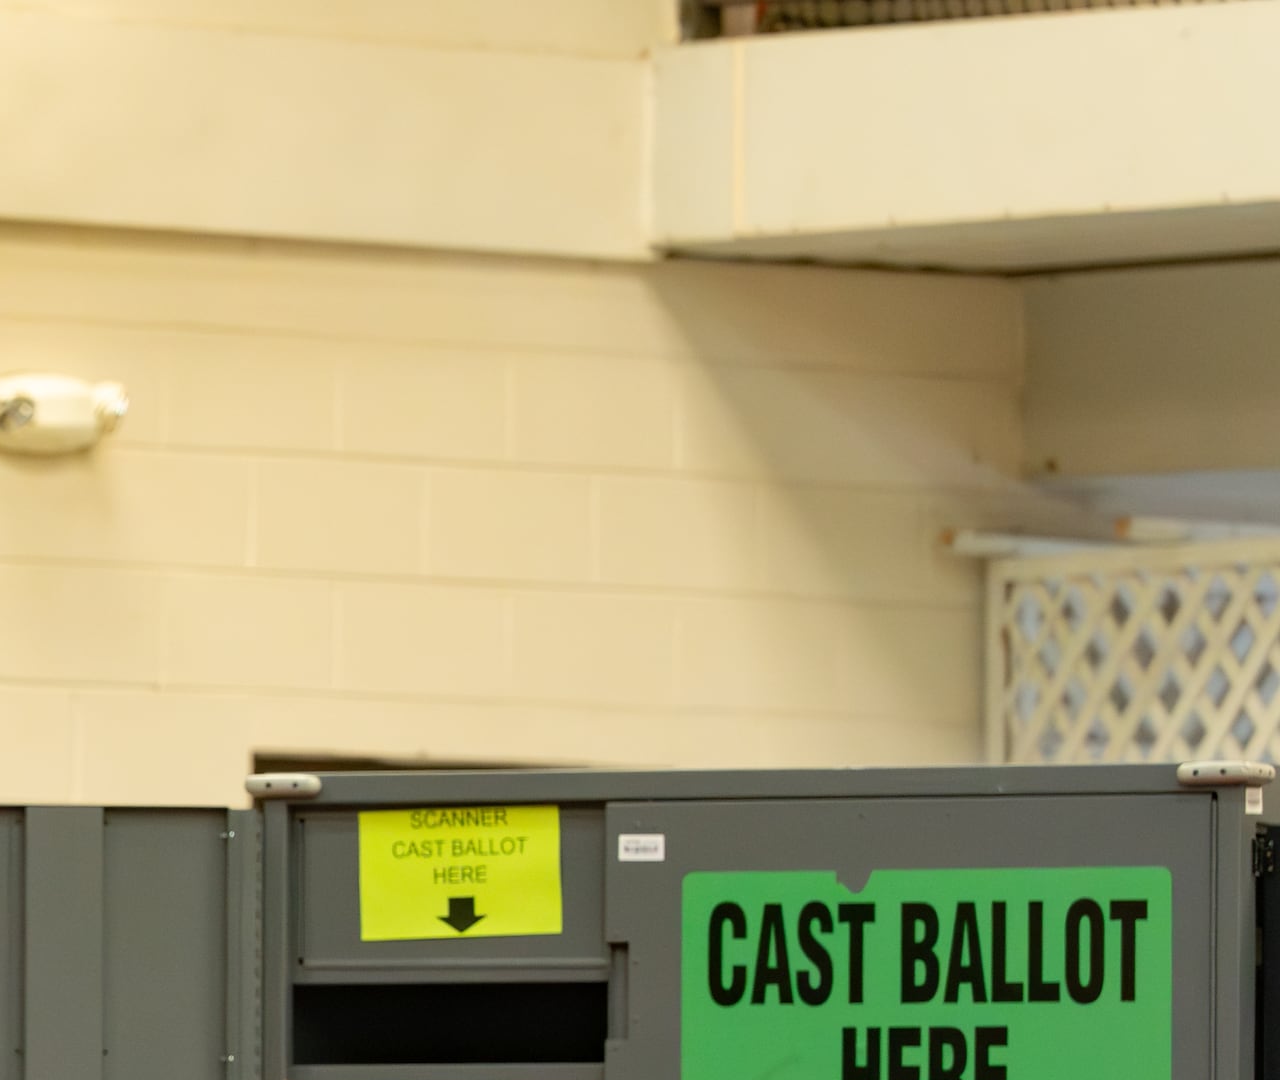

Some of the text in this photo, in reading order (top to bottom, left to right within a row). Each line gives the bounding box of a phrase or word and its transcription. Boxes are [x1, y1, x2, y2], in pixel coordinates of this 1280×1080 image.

[410, 807, 508, 829] SCANNER
[392, 836, 528, 859] CAST BALLOT
[433, 865, 487, 884] HERE
[707, 897, 1148, 1006] CAST BALLOT
